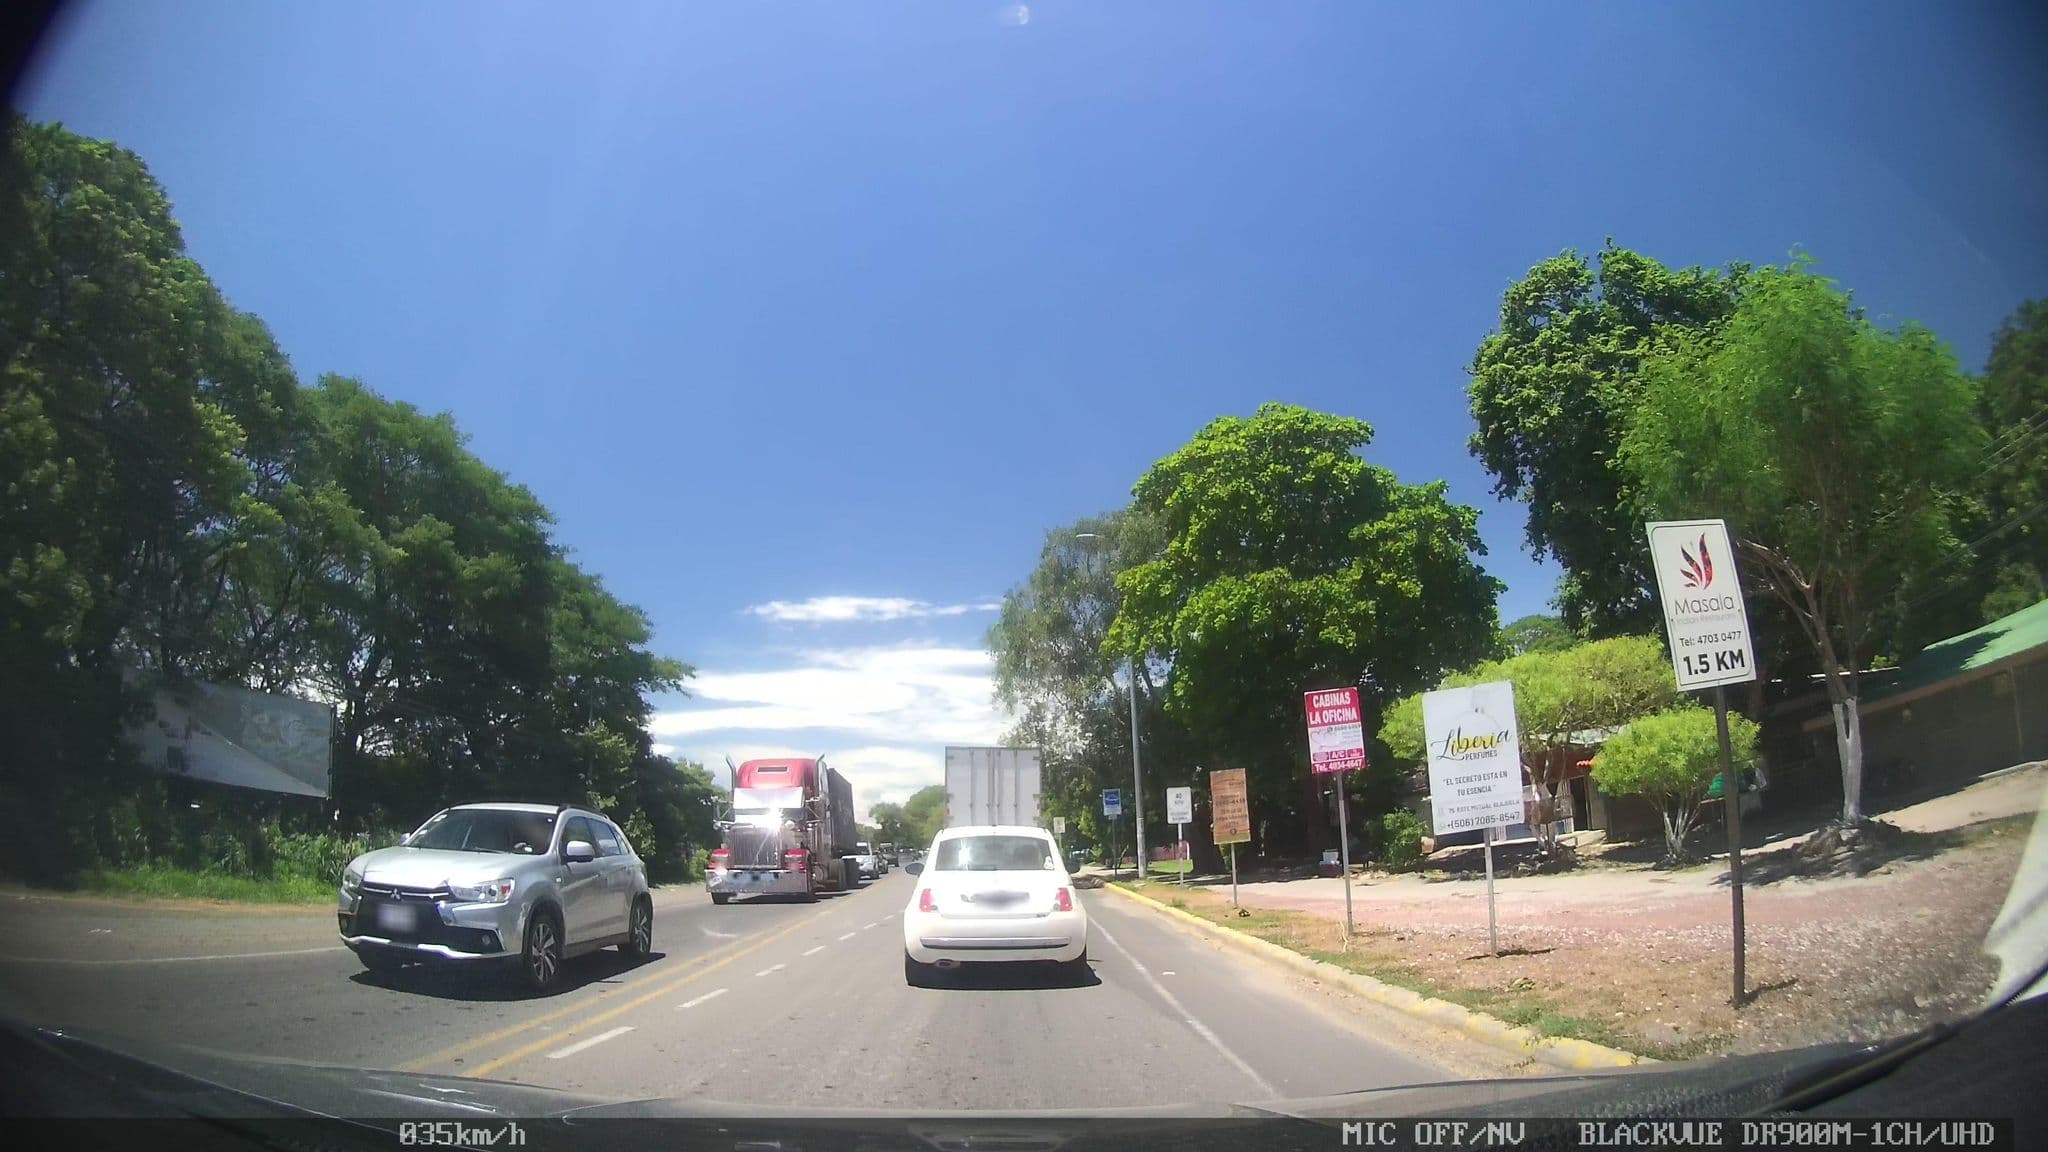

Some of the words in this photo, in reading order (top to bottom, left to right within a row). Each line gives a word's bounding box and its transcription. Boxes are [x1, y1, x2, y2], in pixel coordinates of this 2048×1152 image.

[1675, 594, 1734, 615] Masala
[1679, 635, 1695, 647] Tel:
[1697, 633, 1719, 645] 4703
[1721, 630, 1742, 642] 0477
[1683, 653, 1710, 676] 1.5
[1715, 648, 1745, 671] KM
[1312, 691, 1351, 709] CABINAS
[1308, 711, 1322, 725] LA
[1322, 707, 1358, 723] OFICINA
[1431, 725, 1513, 761] Liberia
[1465, 750, 1498, 761] PERFUMES
[1455, 775, 1482, 785] SECRETO
[1499, 770, 1508, 778] EN
[1457, 788, 1466, 796] TU
